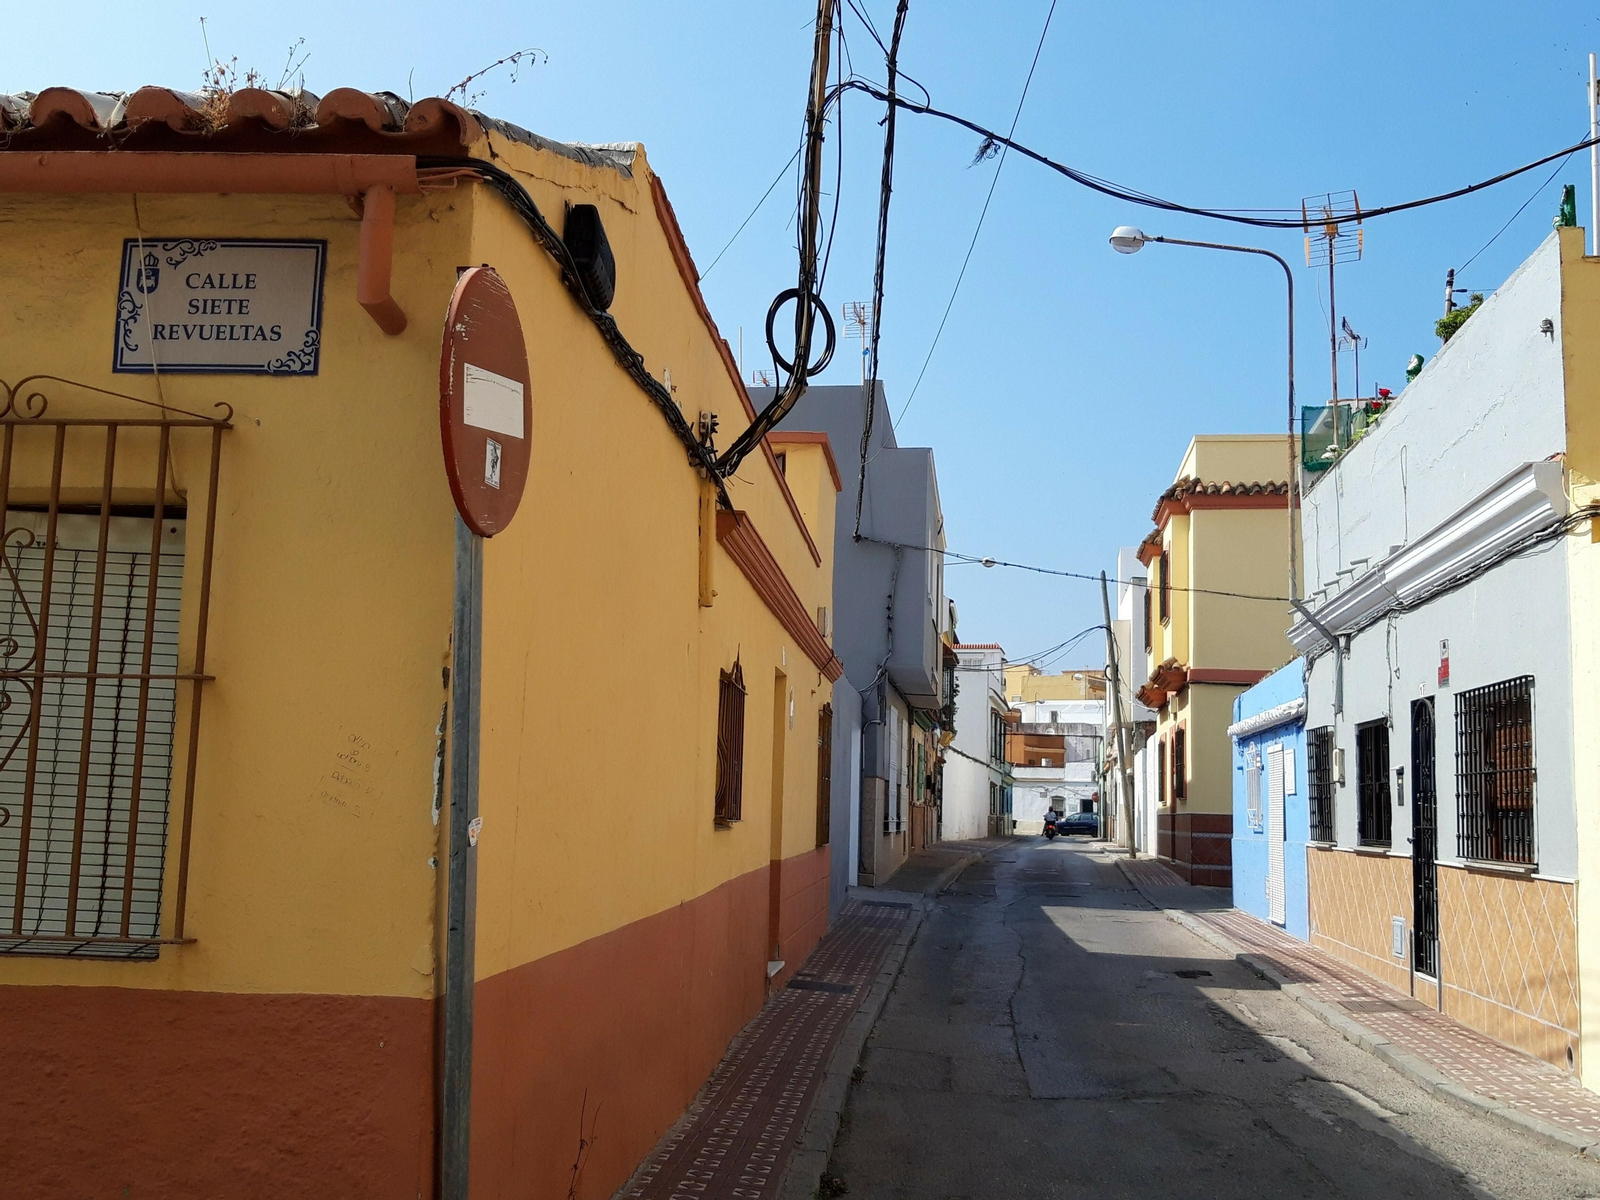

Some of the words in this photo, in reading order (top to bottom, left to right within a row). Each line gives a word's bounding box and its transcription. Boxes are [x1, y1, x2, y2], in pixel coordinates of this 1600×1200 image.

[185, 273, 257, 289] CALLE
[187, 299, 250, 315] SIETE
[153, 324, 282, 341] REVUELTAS
